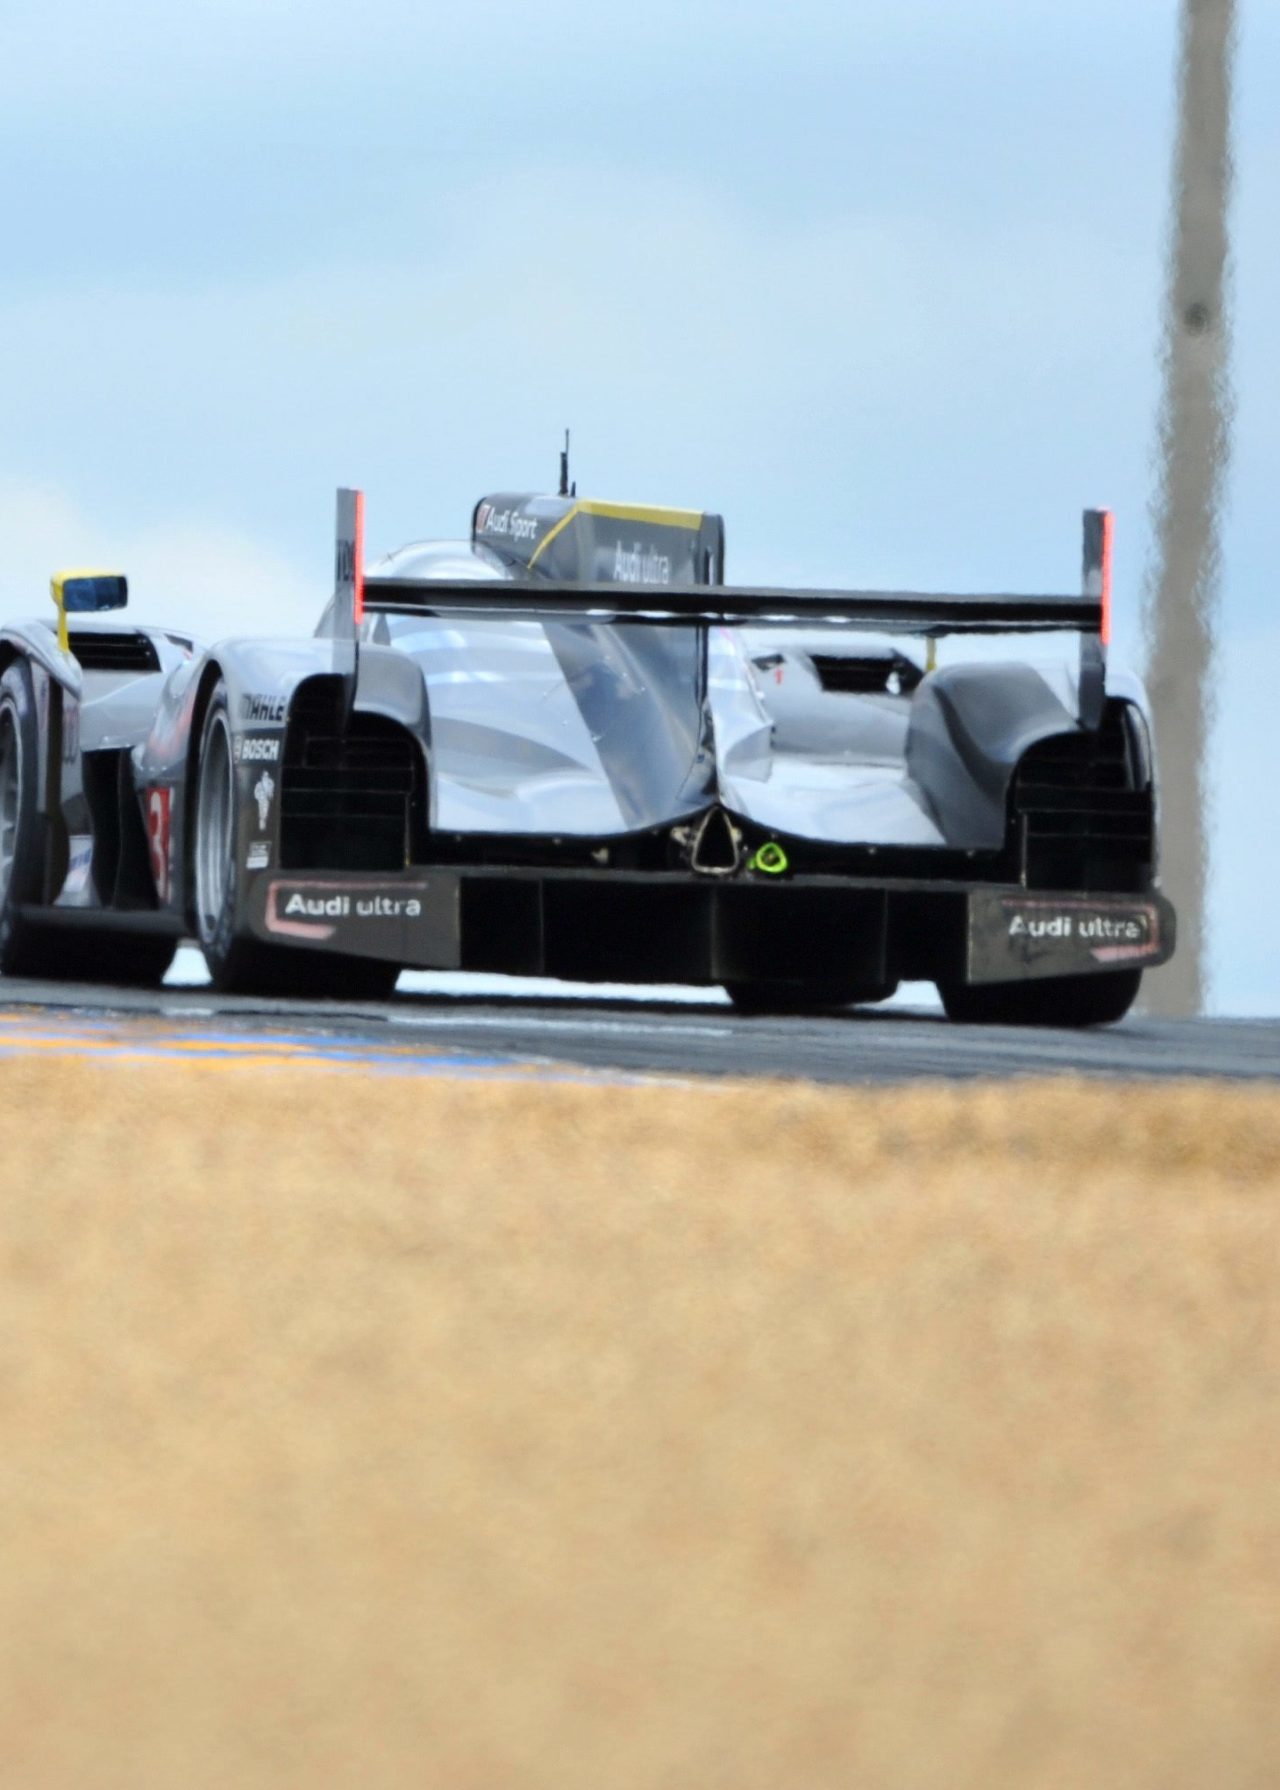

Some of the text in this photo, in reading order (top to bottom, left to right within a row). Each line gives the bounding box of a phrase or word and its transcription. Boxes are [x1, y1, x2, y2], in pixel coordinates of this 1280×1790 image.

[485, 506, 538, 542] Audi Sport
[613, 539, 669, 585] Audi ultra
[242, 738, 280, 761] BOSCH
[285, 893, 421, 917] Audi ultra
[1009, 915, 1141, 939] Audi ultra
